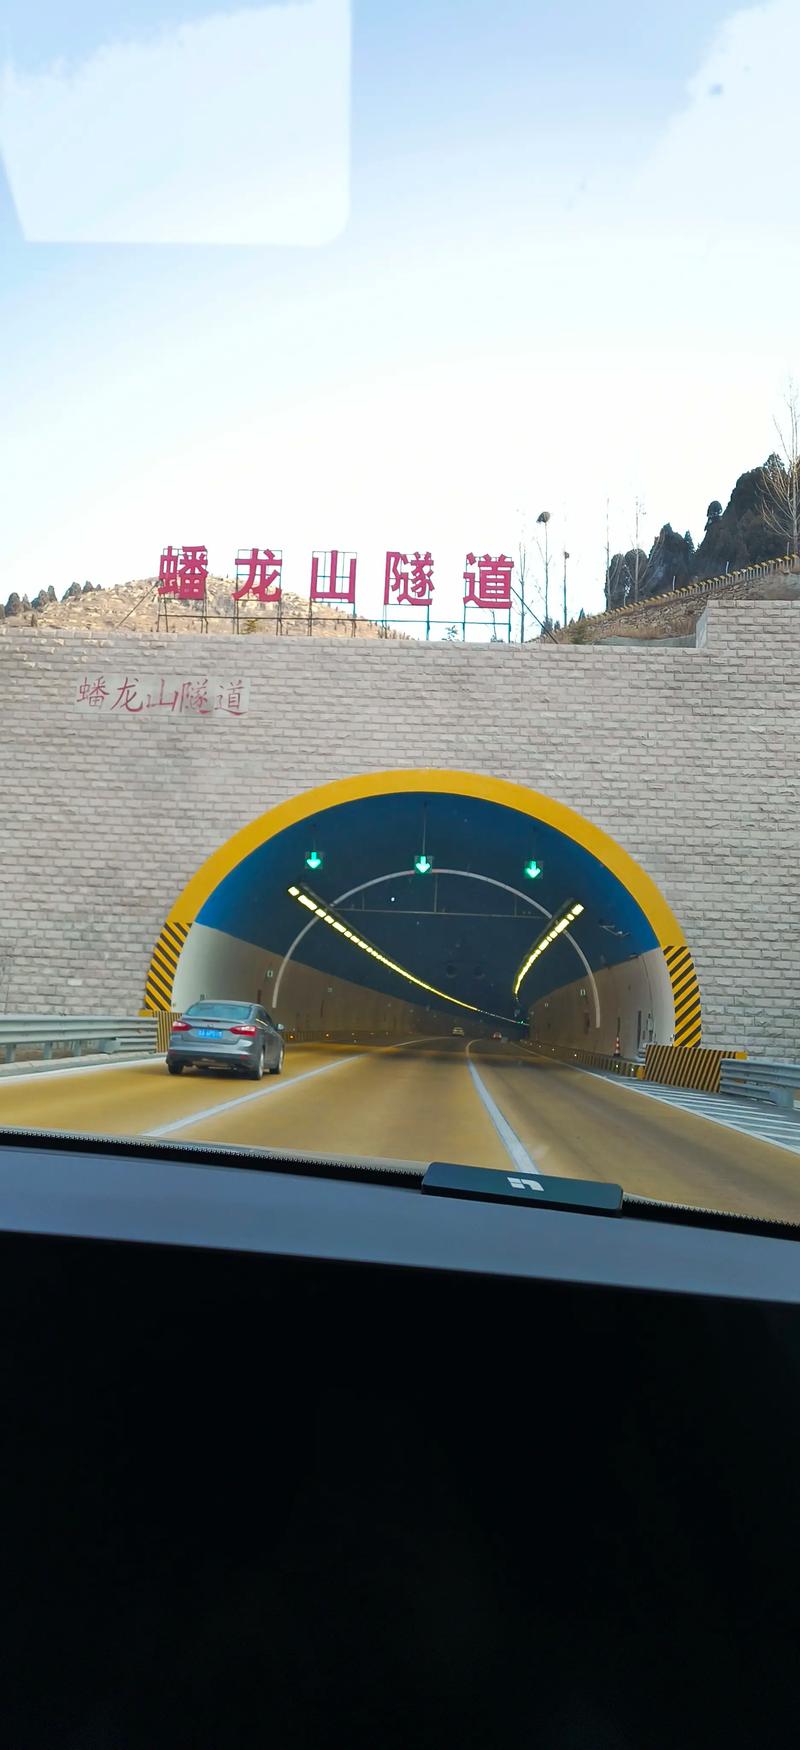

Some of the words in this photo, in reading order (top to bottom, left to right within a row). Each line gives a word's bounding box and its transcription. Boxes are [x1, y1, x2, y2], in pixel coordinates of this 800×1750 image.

[158, 545, 514, 609] 蟠龙山隧道
[76, 675, 248, 716] 蟠龙山隧道
